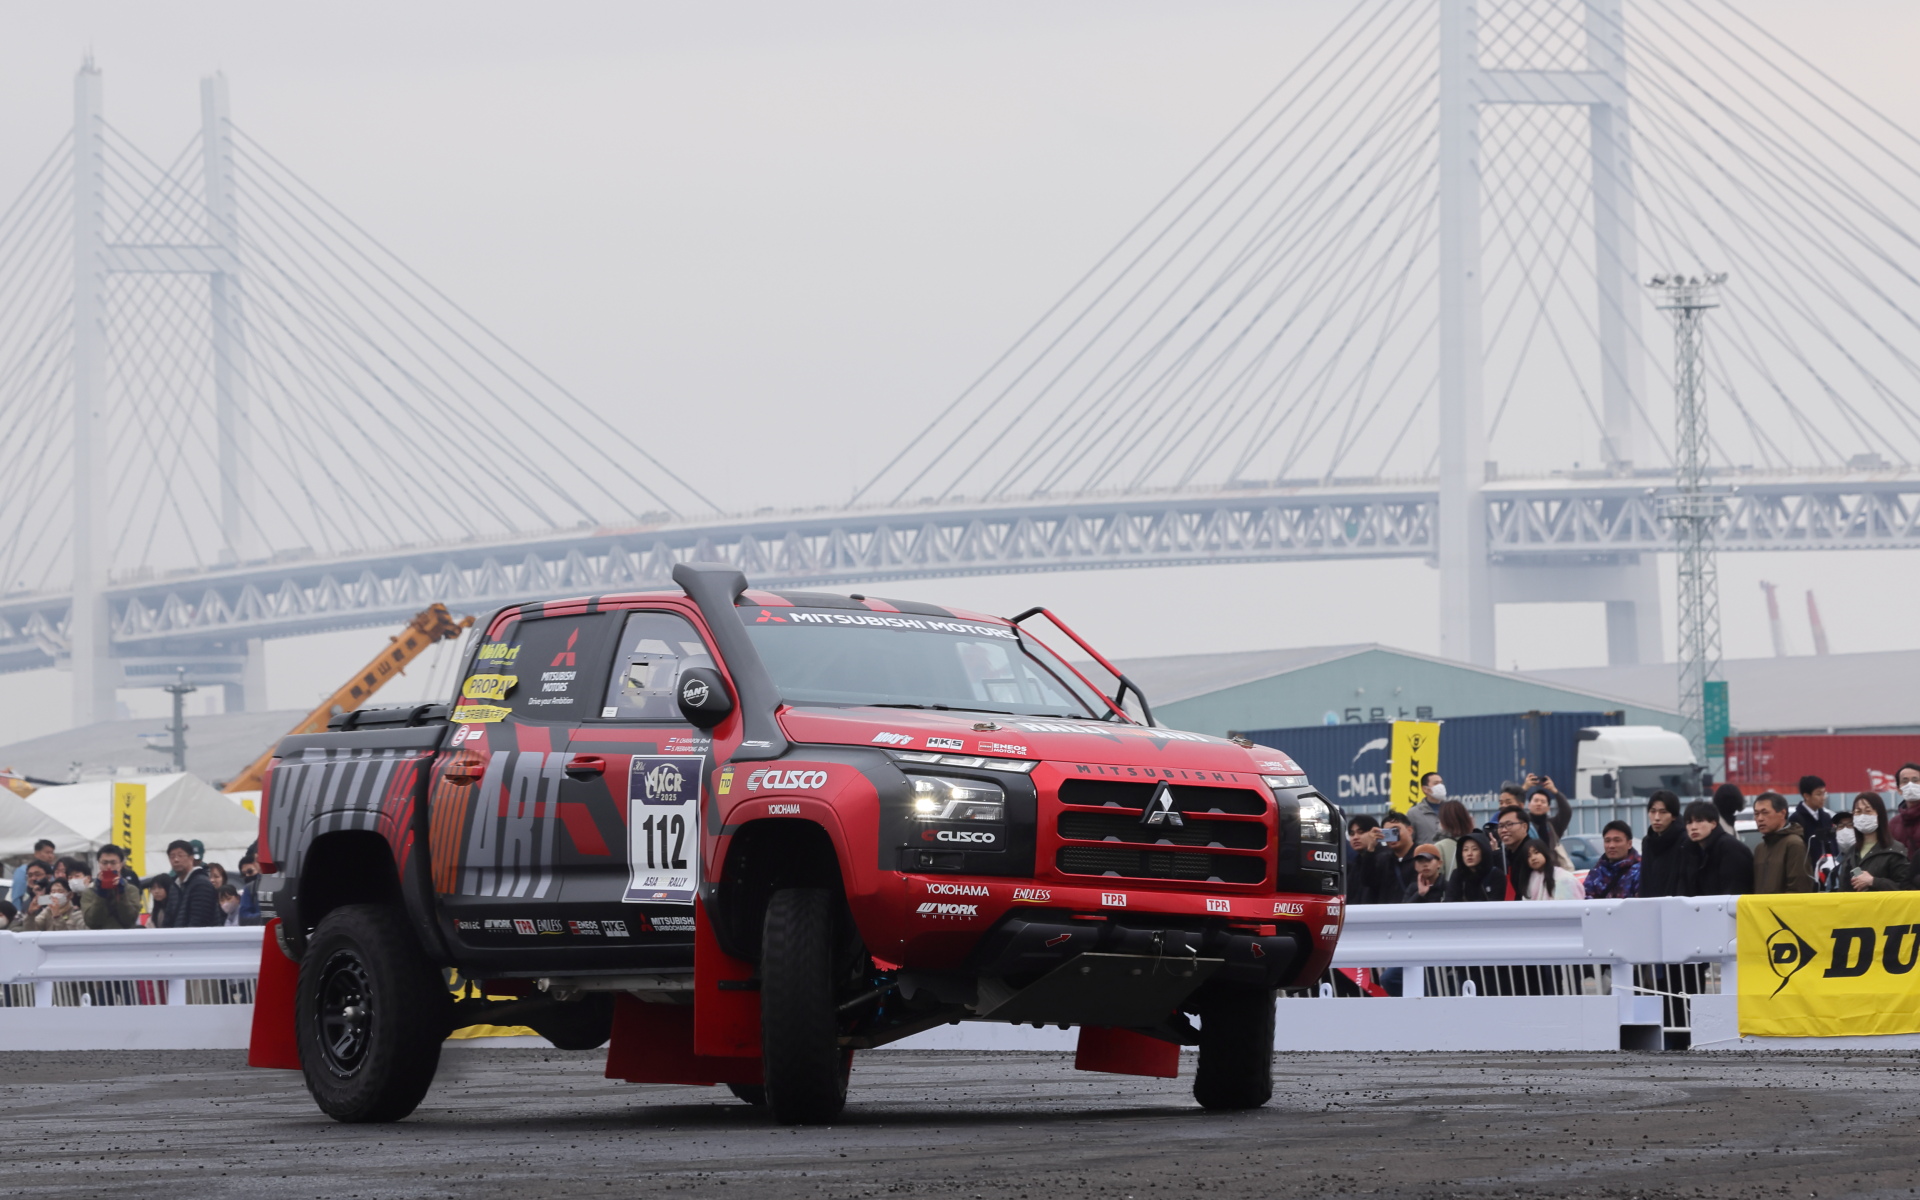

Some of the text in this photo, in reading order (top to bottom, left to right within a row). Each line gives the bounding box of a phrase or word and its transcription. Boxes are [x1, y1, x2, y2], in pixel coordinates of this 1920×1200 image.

[789, 612, 1019, 640] MITSUBISHI MOTORS
[540, 671, 577, 681] MITSUBISHI
[541, 682, 568, 692] MOTORS
[683, 685, 709, 698] TANT
[528, 697, 540, 705] Drive
[540, 698, 551, 706] your
[872, 732, 914, 745] Moty's
[928, 738, 962, 748] HKS
[993, 743, 1027, 751] ENEOS
[1076, 764, 1240, 783] MITSUBISHI
[1337, 773, 1378, 798] CMA
[768, 804, 800, 815] YOKOHAMA
[642, 814, 688, 870] 112
[936, 830, 996, 844] CUSCO
[1314, 851, 1338, 862] CUSCO
[643, 876, 659, 887] ASIA
[667, 877, 688, 888] RALLY
[926, 884, 990, 897] YOKOHAMA
[1012, 888, 1052, 900] ENDLESS
[1104, 894, 1125, 906] TPR
[1208, 899, 1229, 911] TPR
[936, 903, 978, 915] WORK
[1273, 903, 1304, 914] ENDLESS
[515, 920, 537, 934] TPR
[537, 919, 563, 932] ENDLESS
[576, 920, 599, 929] ENEOS
[601, 921, 627, 932] HKS
[650, 917, 695, 926] MITSUBISHI
